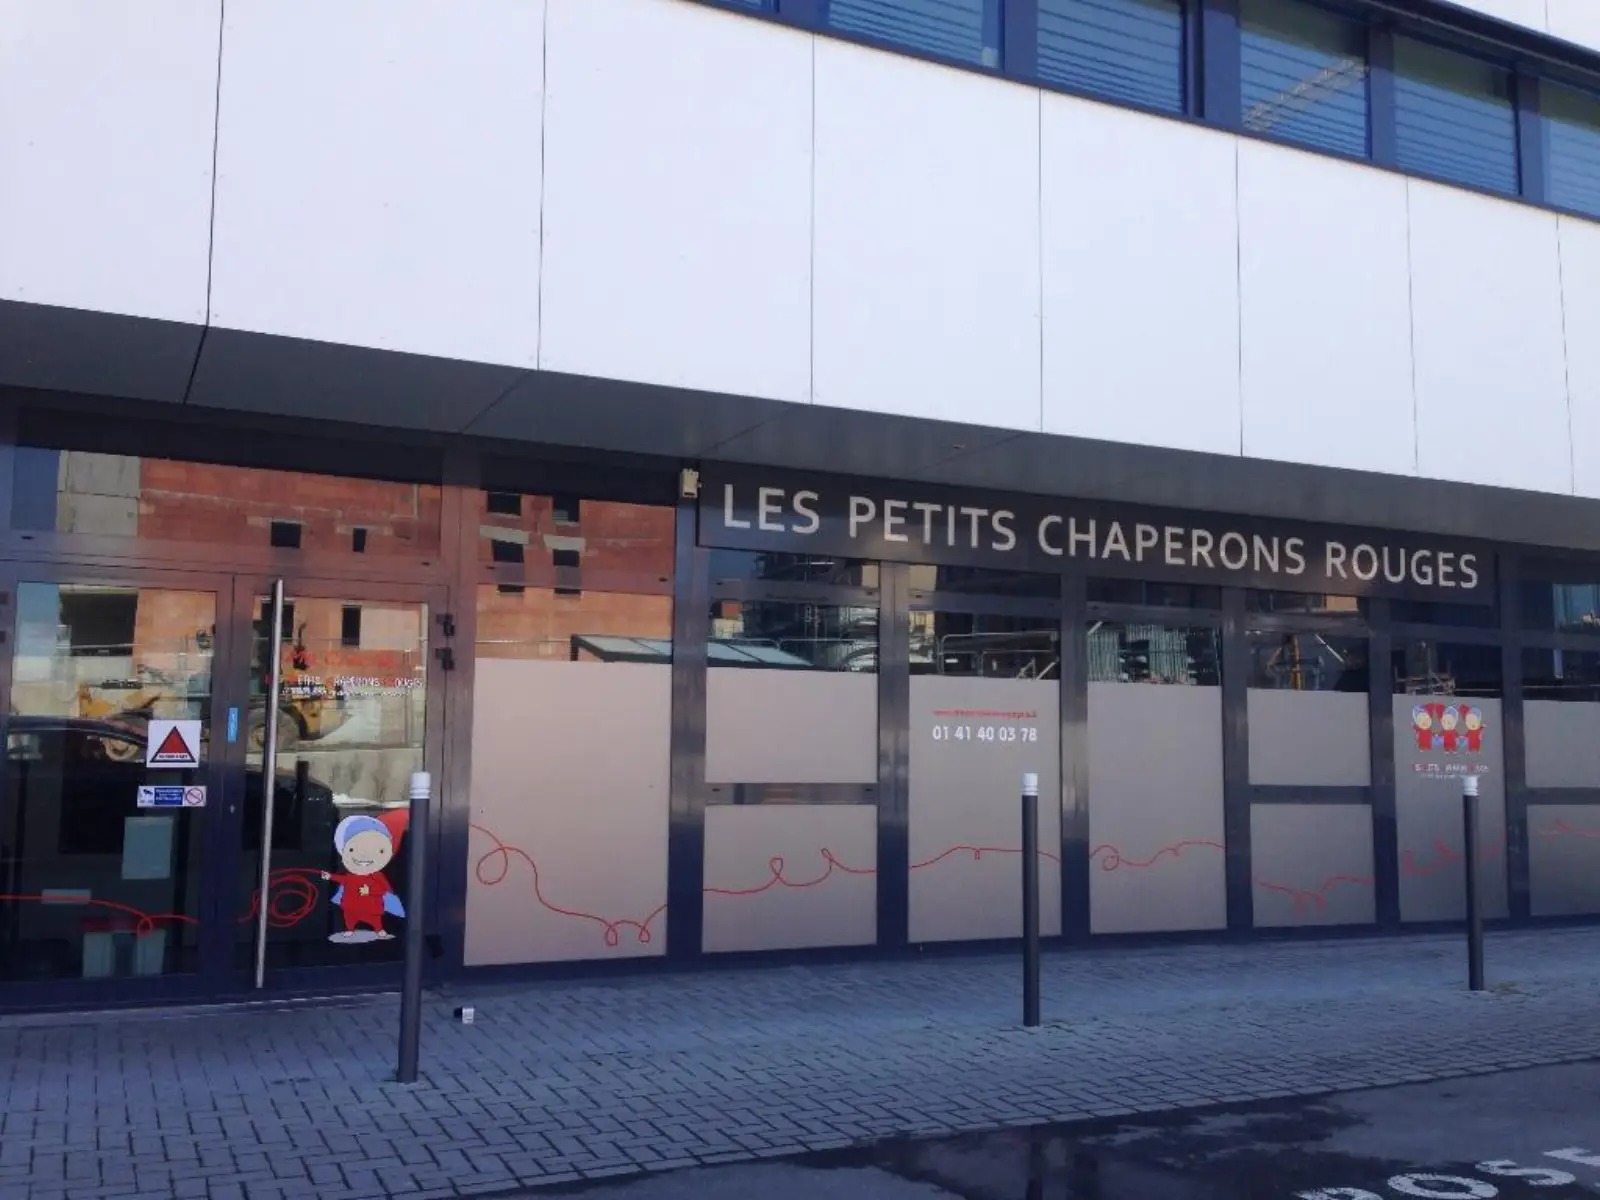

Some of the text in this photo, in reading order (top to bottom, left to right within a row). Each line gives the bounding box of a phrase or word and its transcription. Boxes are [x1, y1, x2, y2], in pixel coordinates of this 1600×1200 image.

[724, 483, 1478, 589] LES PETITS CHAPERONS ROUGES
[932, 725, 1038, 742] 01 41 40 03 78
